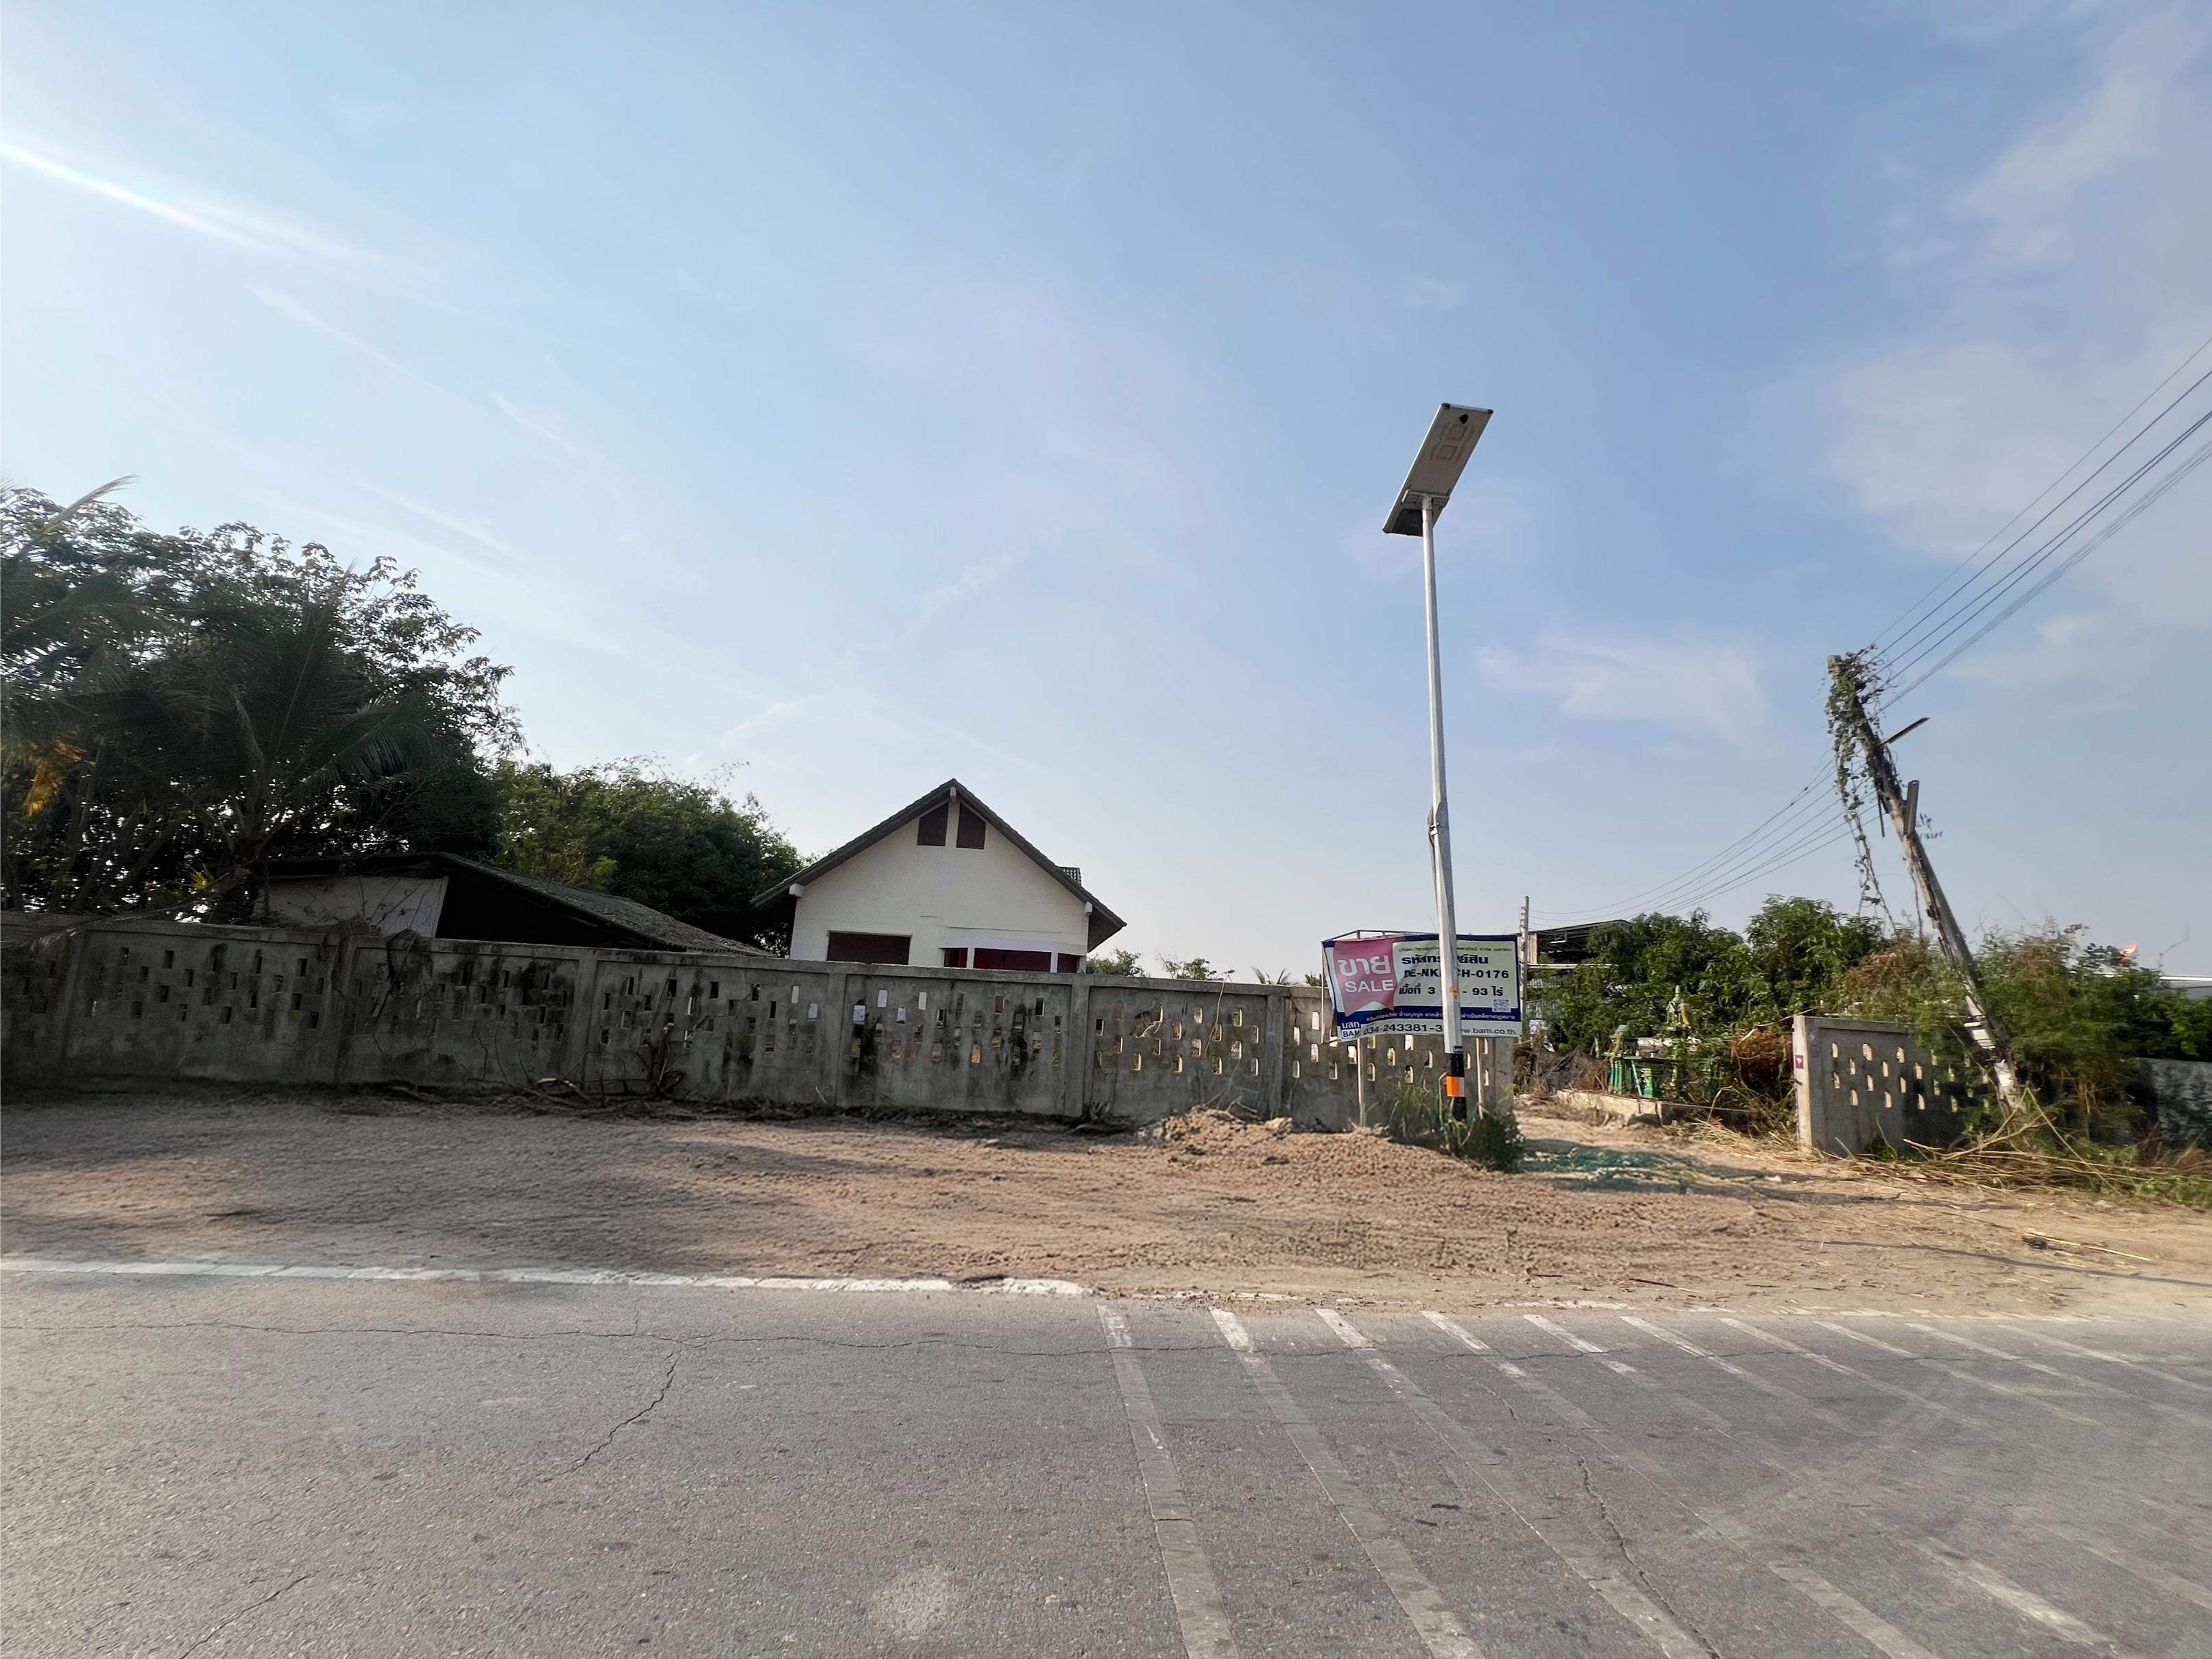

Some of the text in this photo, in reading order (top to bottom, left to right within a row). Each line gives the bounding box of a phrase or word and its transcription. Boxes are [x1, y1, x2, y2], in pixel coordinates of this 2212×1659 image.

[1337, 955, 1391, 977] ขาย
[1345, 979, 1395, 992] SALE
[1472, 988, 1488, 996] 93
[1491, 986, 1504, 996] ไร่
[1343, 1029, 1360, 1038] BAM
